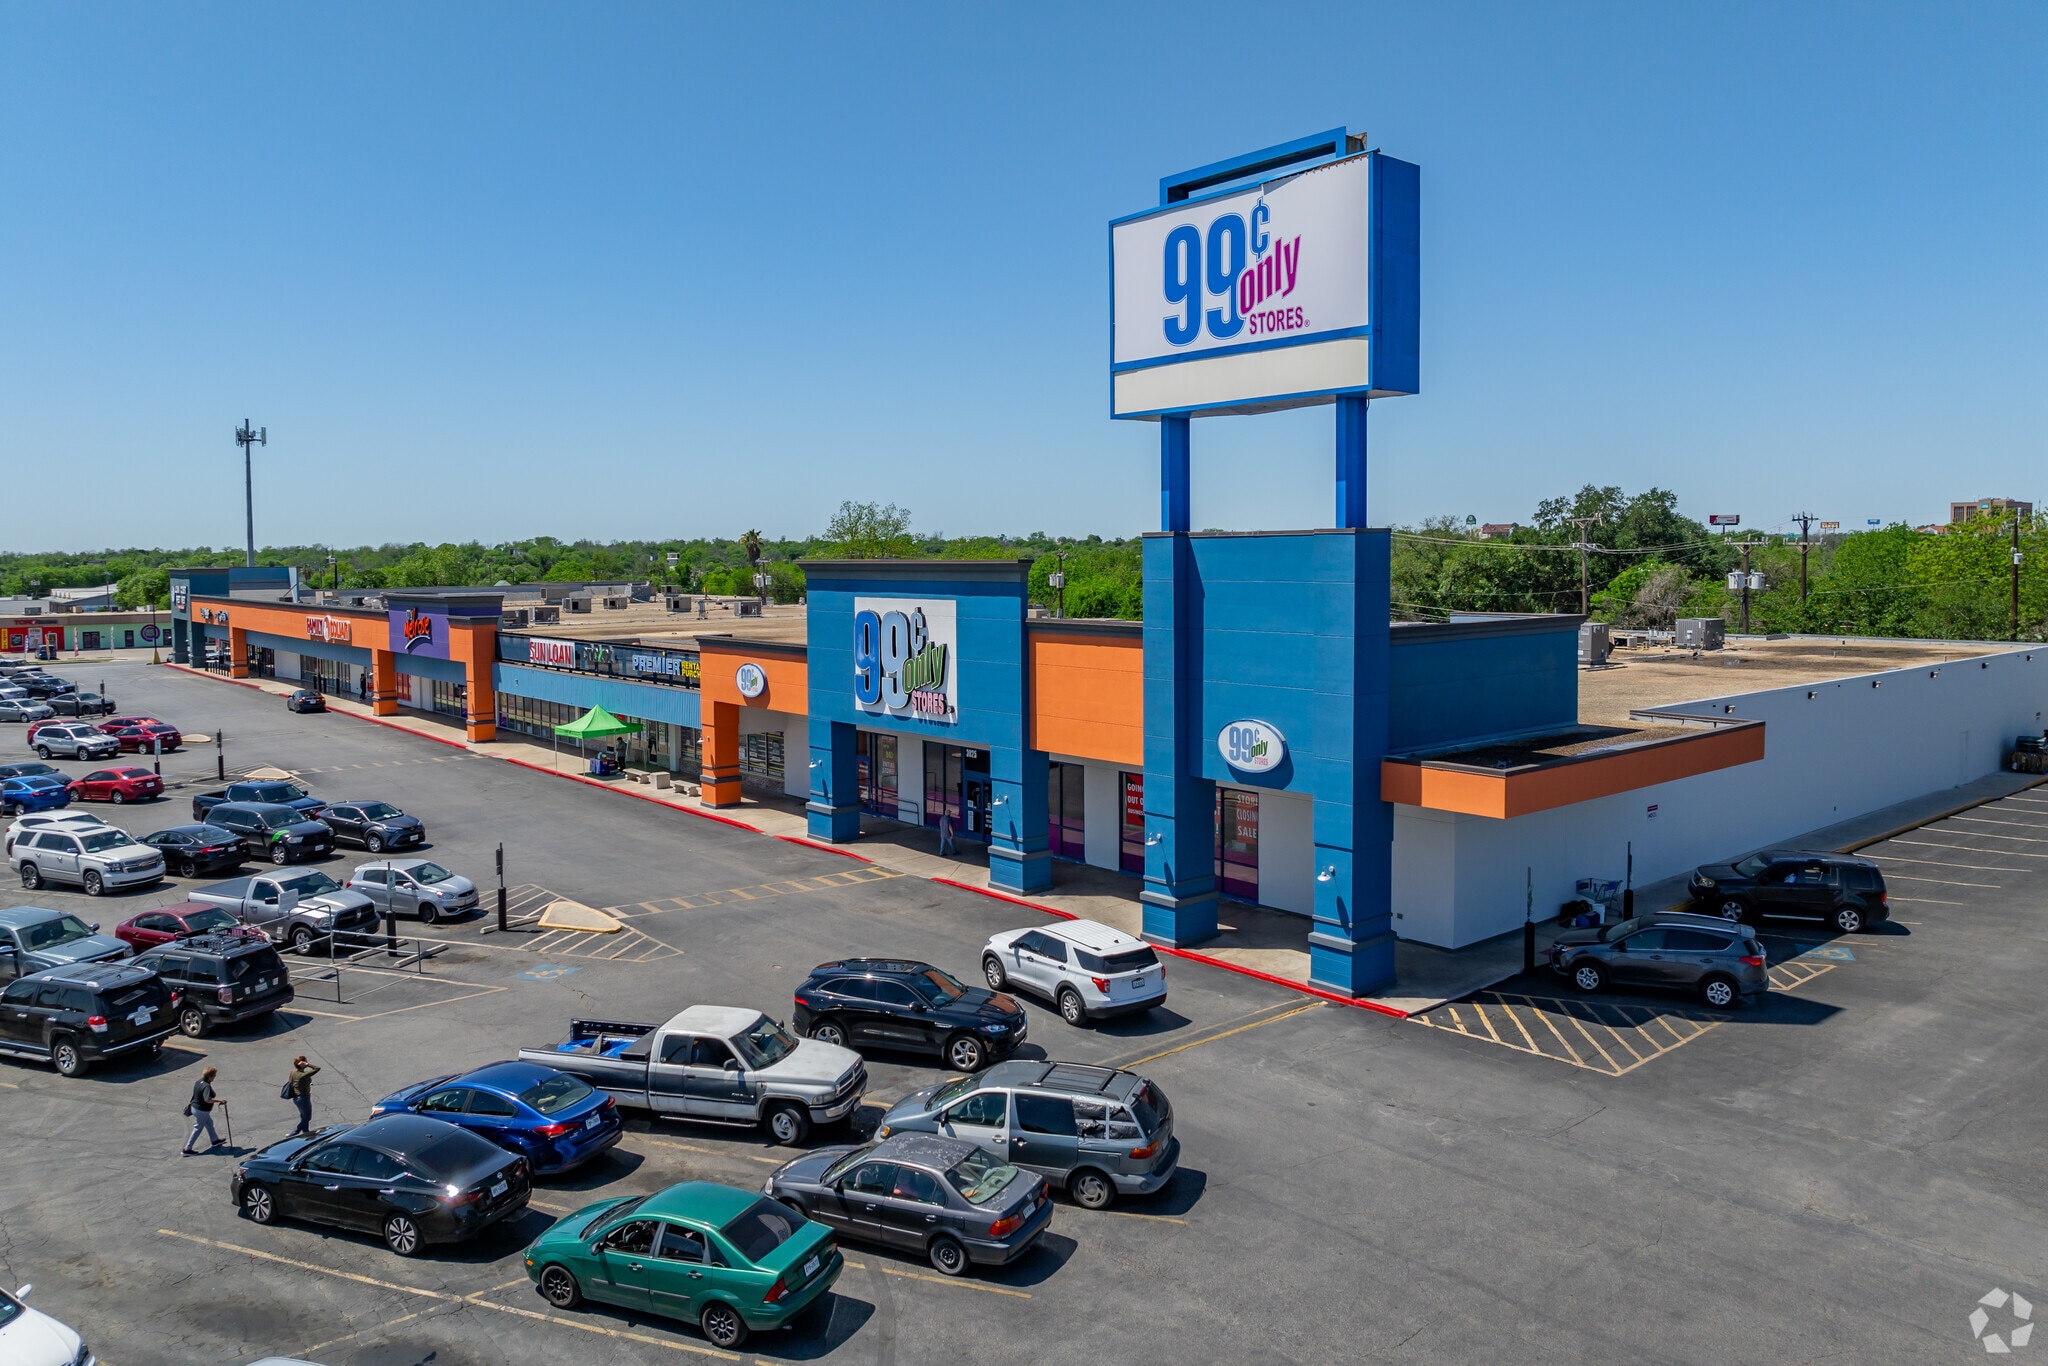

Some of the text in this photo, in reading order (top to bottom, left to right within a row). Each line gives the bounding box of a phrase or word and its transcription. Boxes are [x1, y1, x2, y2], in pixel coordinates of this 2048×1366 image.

[1240, 234, 1301, 315] only
[306, 616, 323, 636] FAMILY
[529, 641, 545, 662] SUN
[548, 643, 571, 665] LOAN
[632, 654, 681, 676] PREMIER
[681, 661, 700, 671] RENTA
[904, 641, 947, 693] only
[911, 690, 945, 716] STORES
[1251, 740, 1268, 758] only
[1127, 795, 1138, 805] OUT
[1236, 808, 1258, 822] CLOSIN
[1238, 826, 1257, 839] SALE
